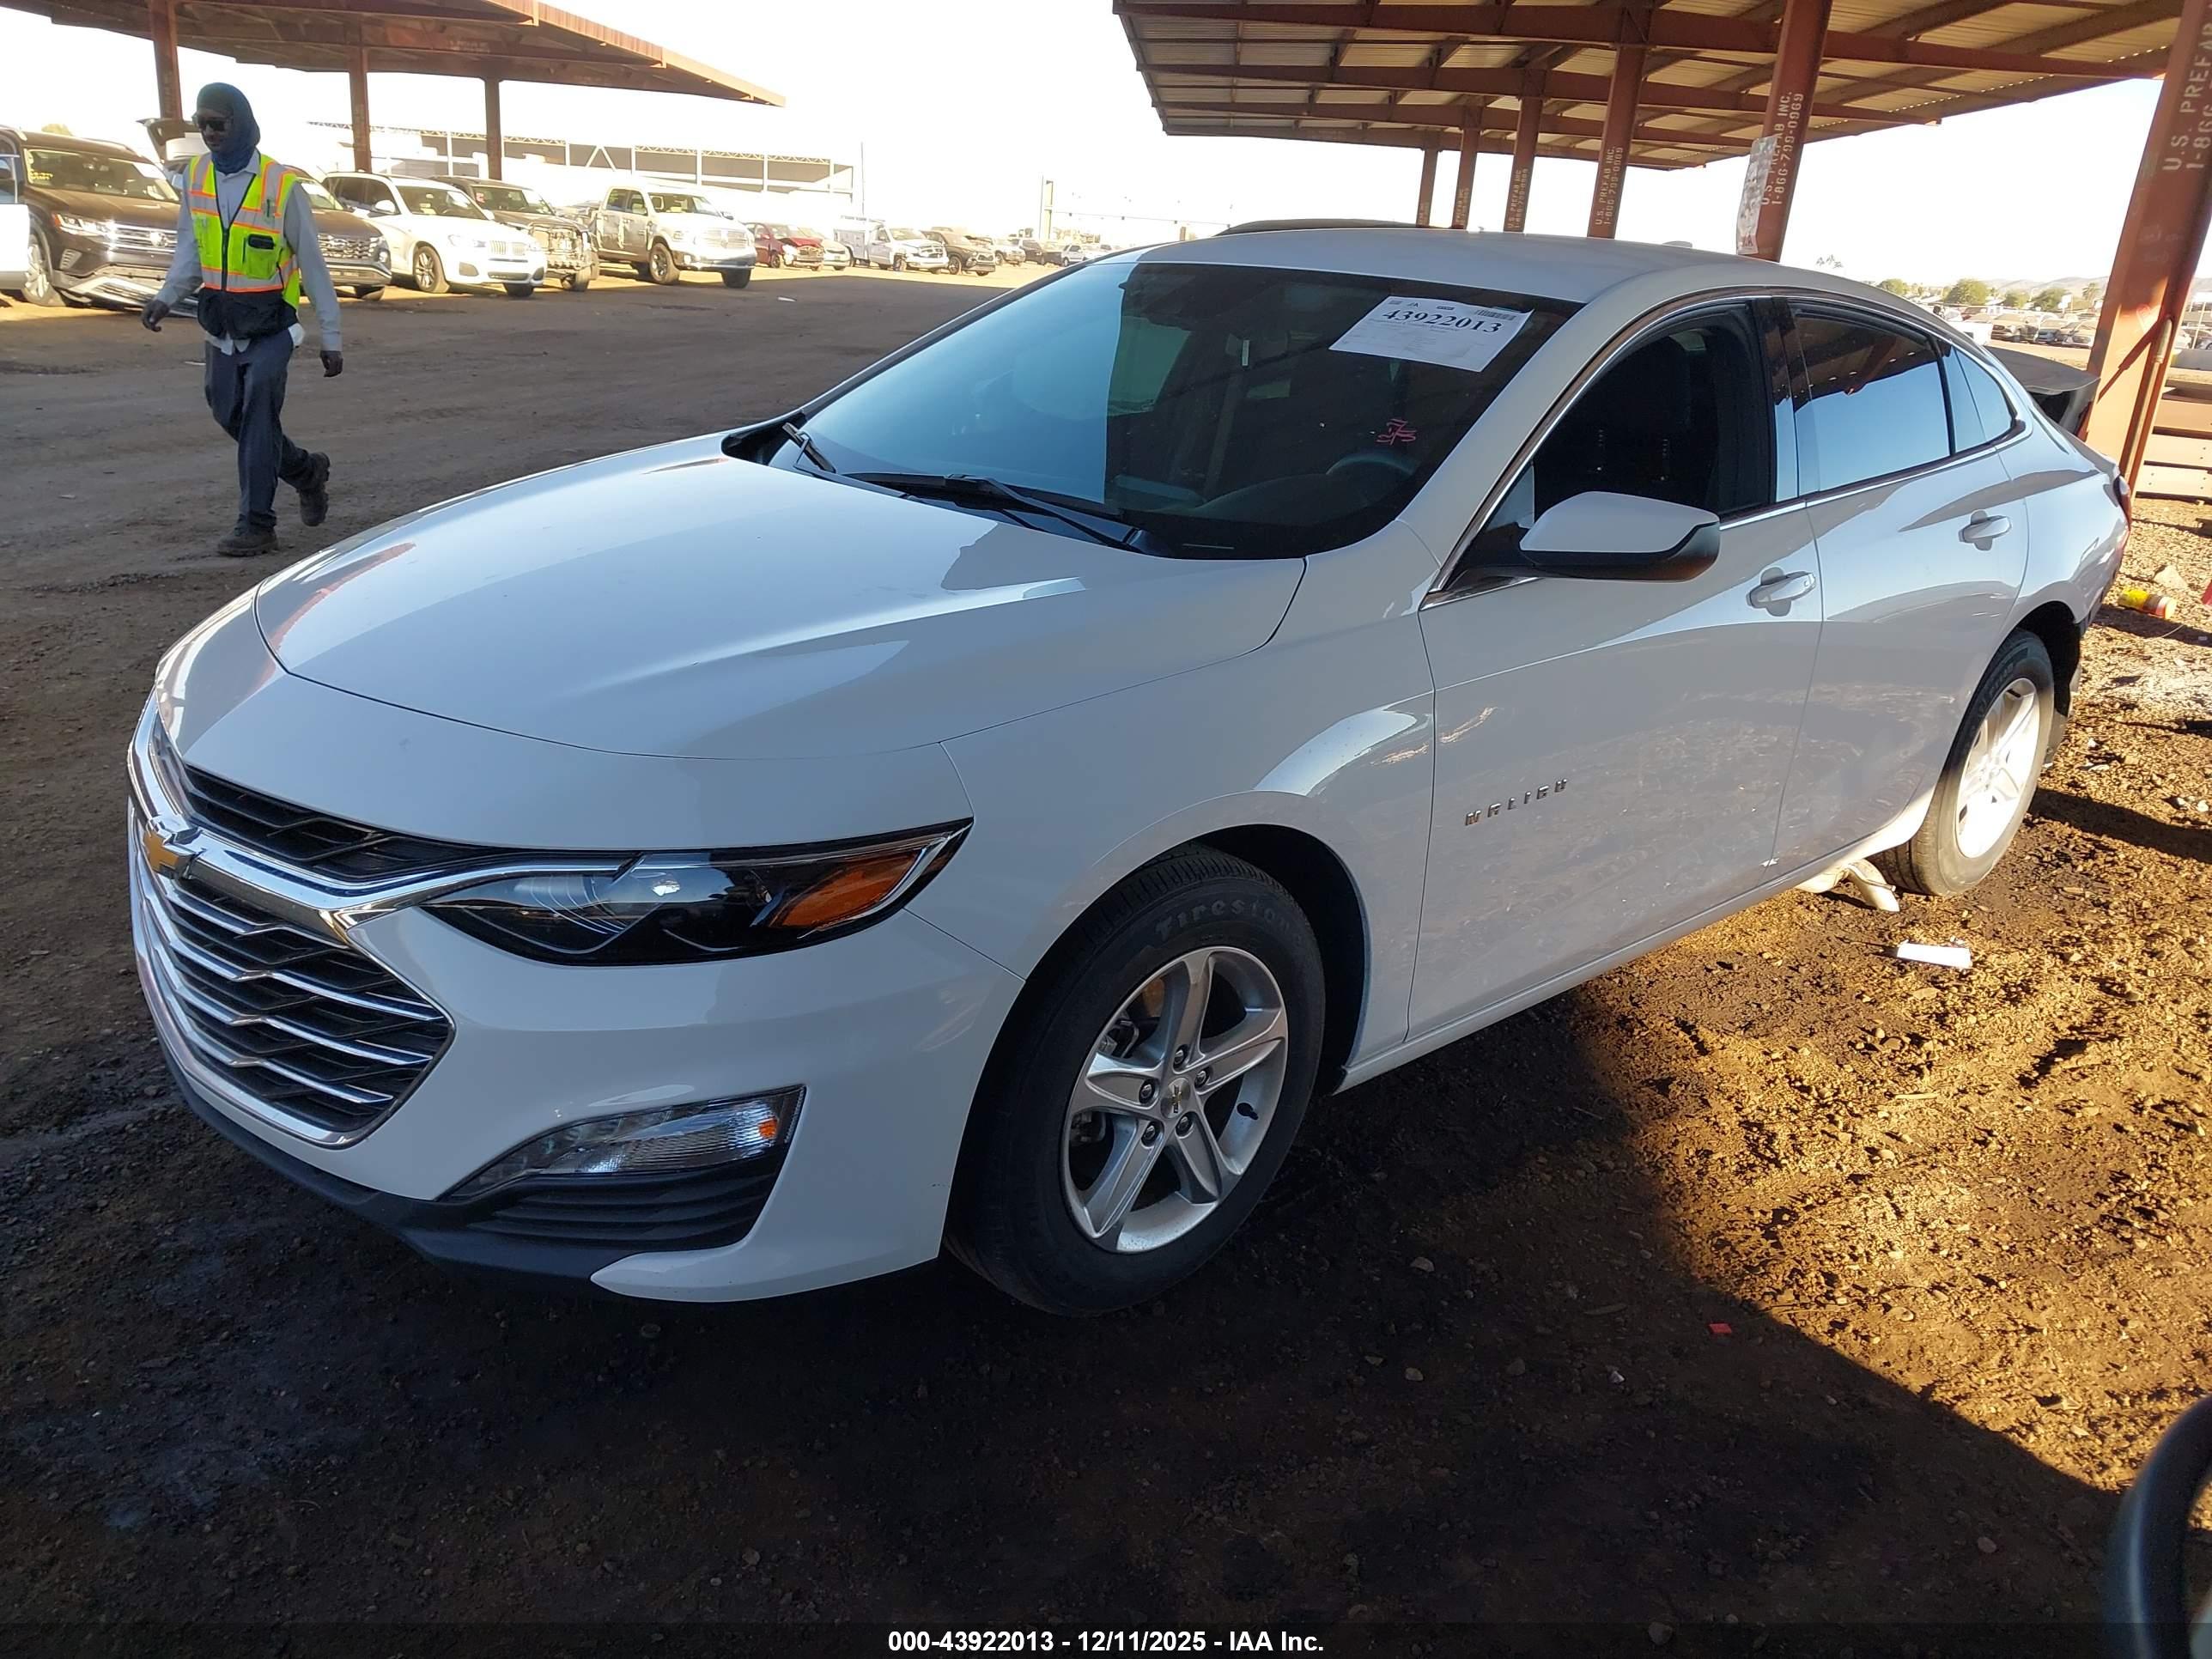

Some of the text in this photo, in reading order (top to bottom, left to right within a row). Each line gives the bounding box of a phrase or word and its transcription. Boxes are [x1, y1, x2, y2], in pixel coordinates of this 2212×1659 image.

[1778, 91, 1793, 117] INC.
[1771, 93, 1803, 205] 1-866-799-0969
[2162, 127, 2192, 171] U.S.
[1382, 309, 1504, 333] 43922013
